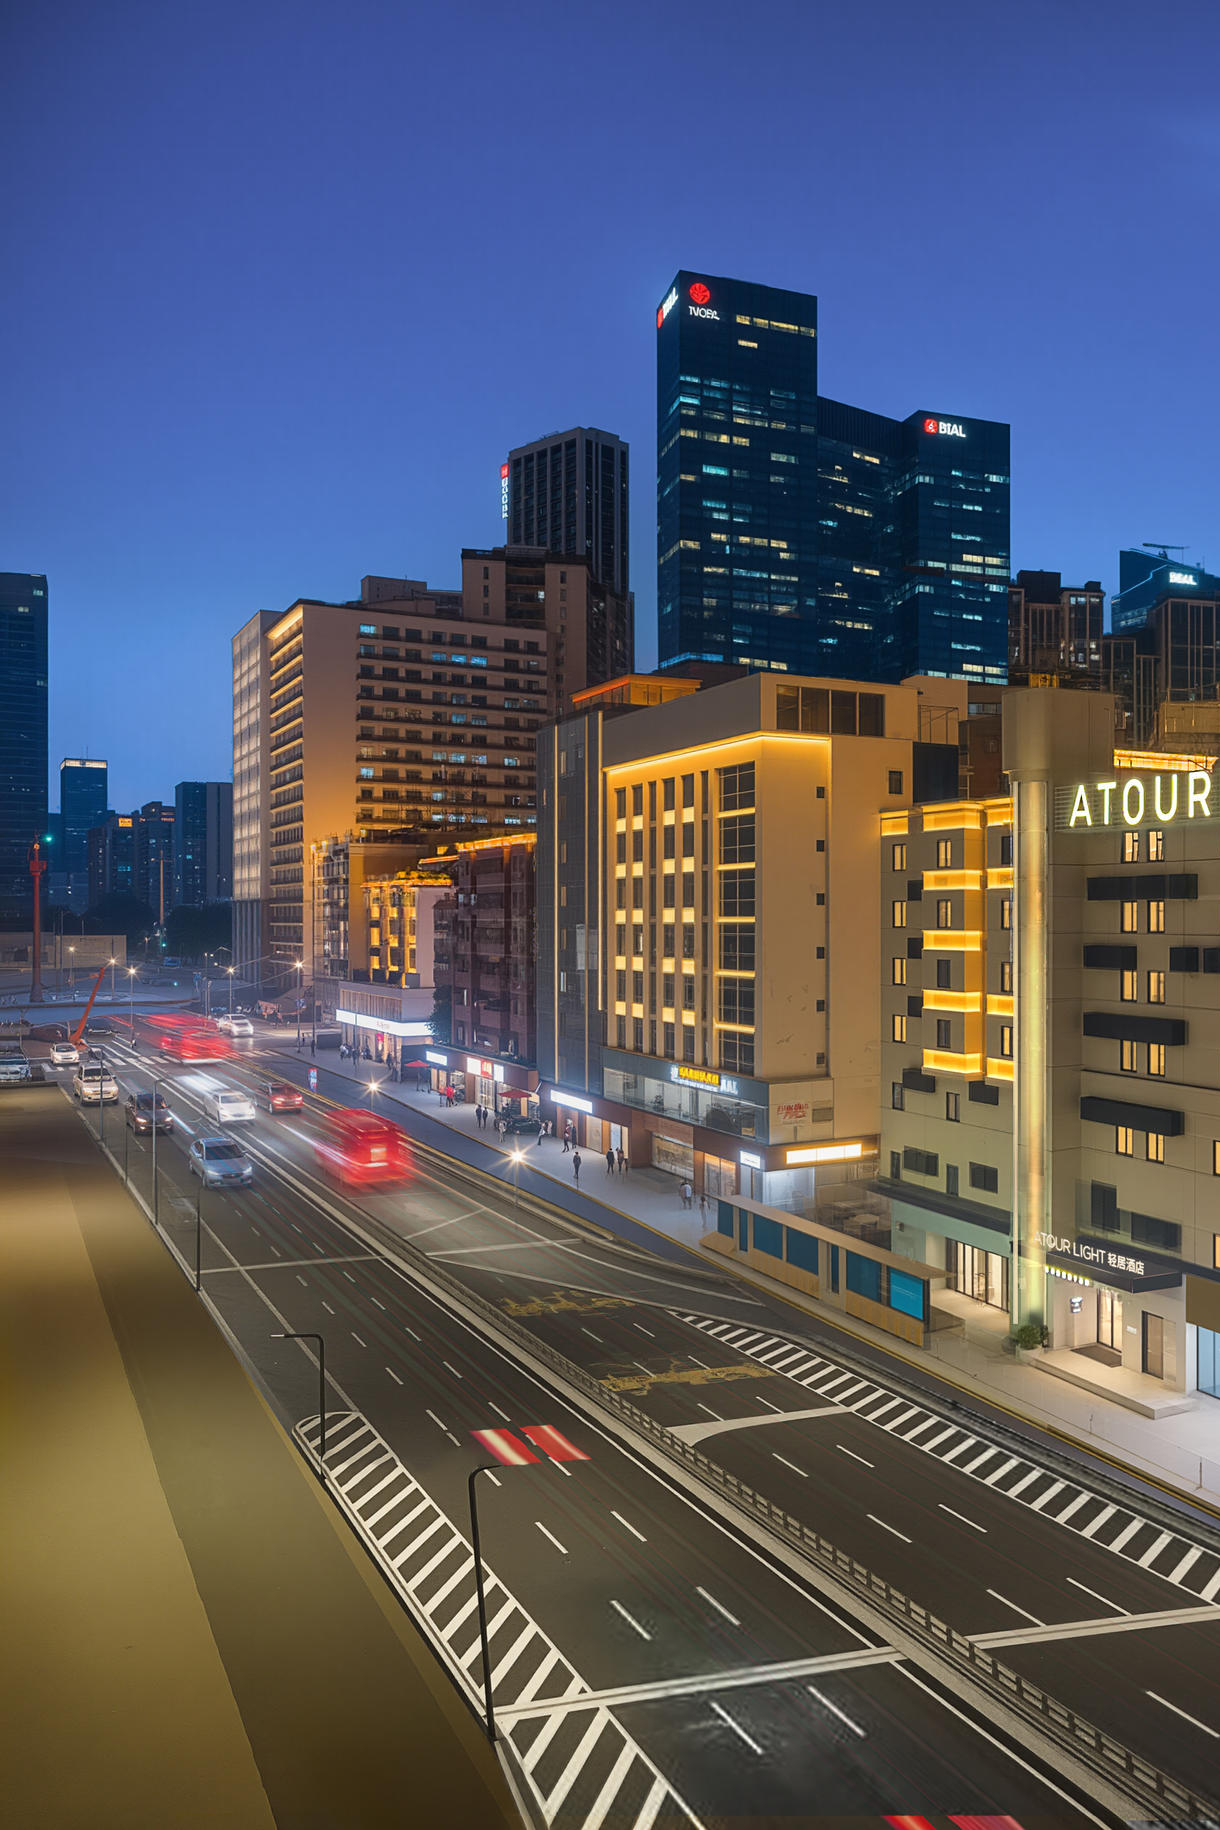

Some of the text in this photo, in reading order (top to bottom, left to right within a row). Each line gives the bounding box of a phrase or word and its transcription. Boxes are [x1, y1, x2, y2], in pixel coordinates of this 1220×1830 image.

[1069, 771, 1212, 827] ATOUR
[1033, 1232, 1145, 1275] ATOUR LIGHT 轻居酒店
